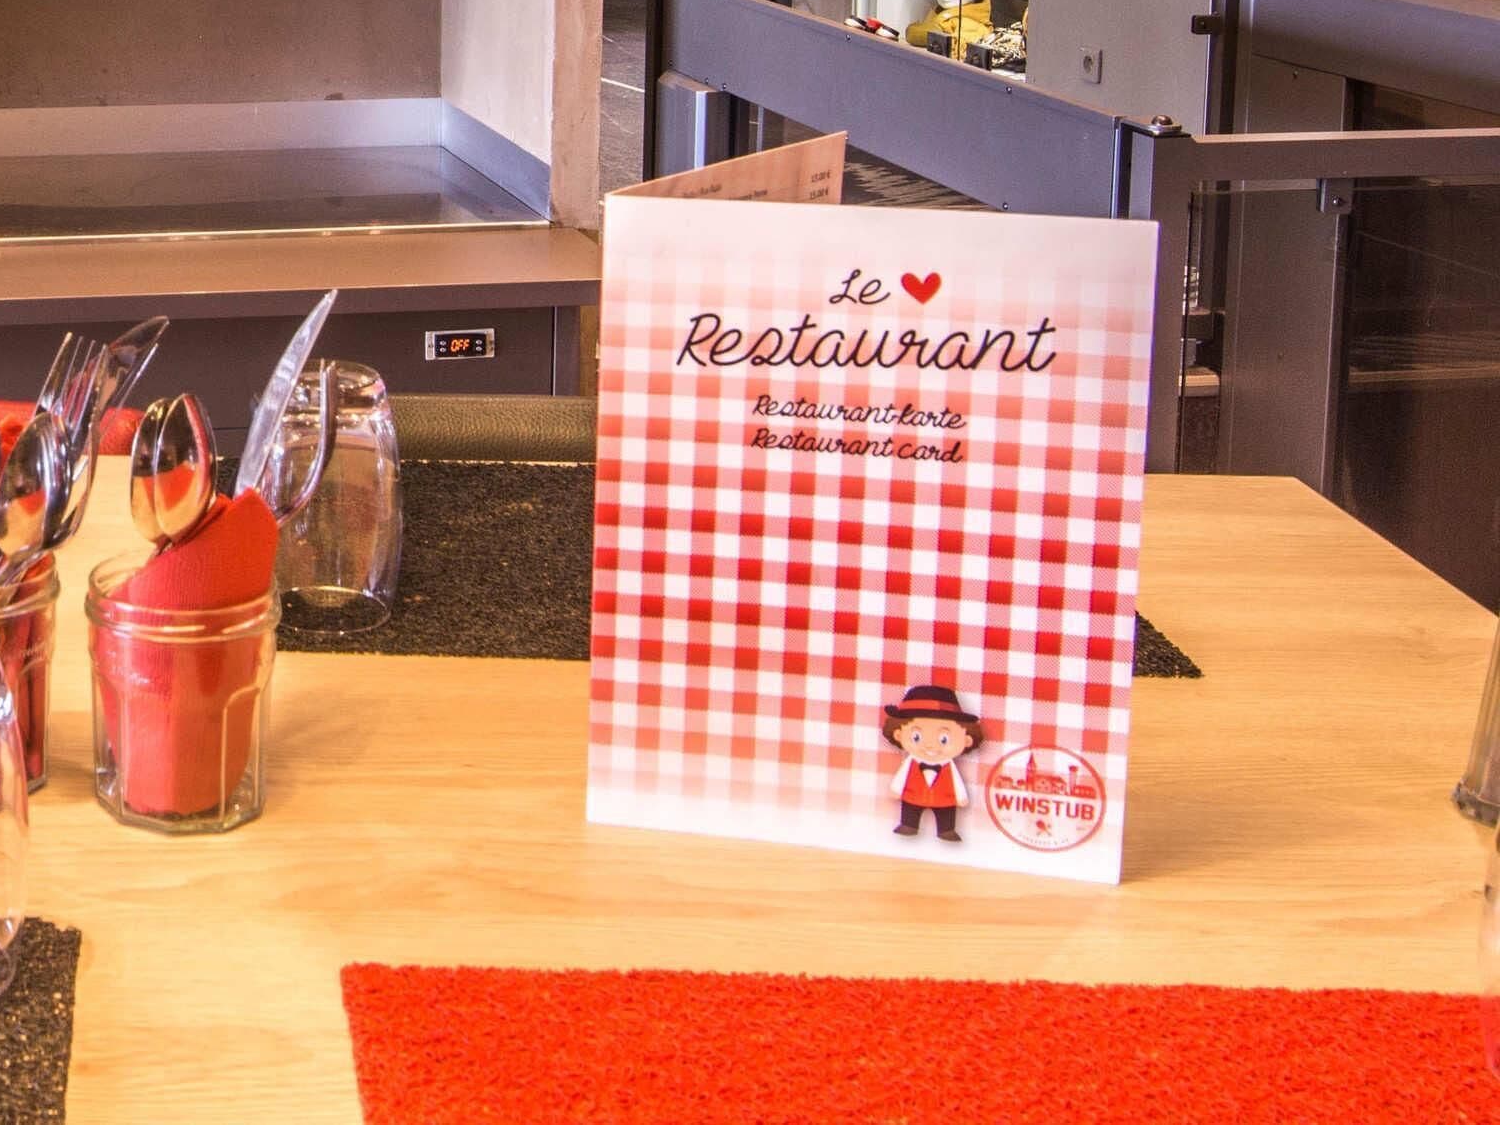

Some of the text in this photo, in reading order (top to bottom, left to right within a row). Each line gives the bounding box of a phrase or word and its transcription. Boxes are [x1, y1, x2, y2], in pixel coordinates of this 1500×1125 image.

[828, 268, 891, 306] Le
[450, 338, 470, 353] OFF
[676, 311, 1058, 373] Restaurant
[750, 426, 965, 464] Restaurant card
[995, 792, 1095, 821] WINSTUB
